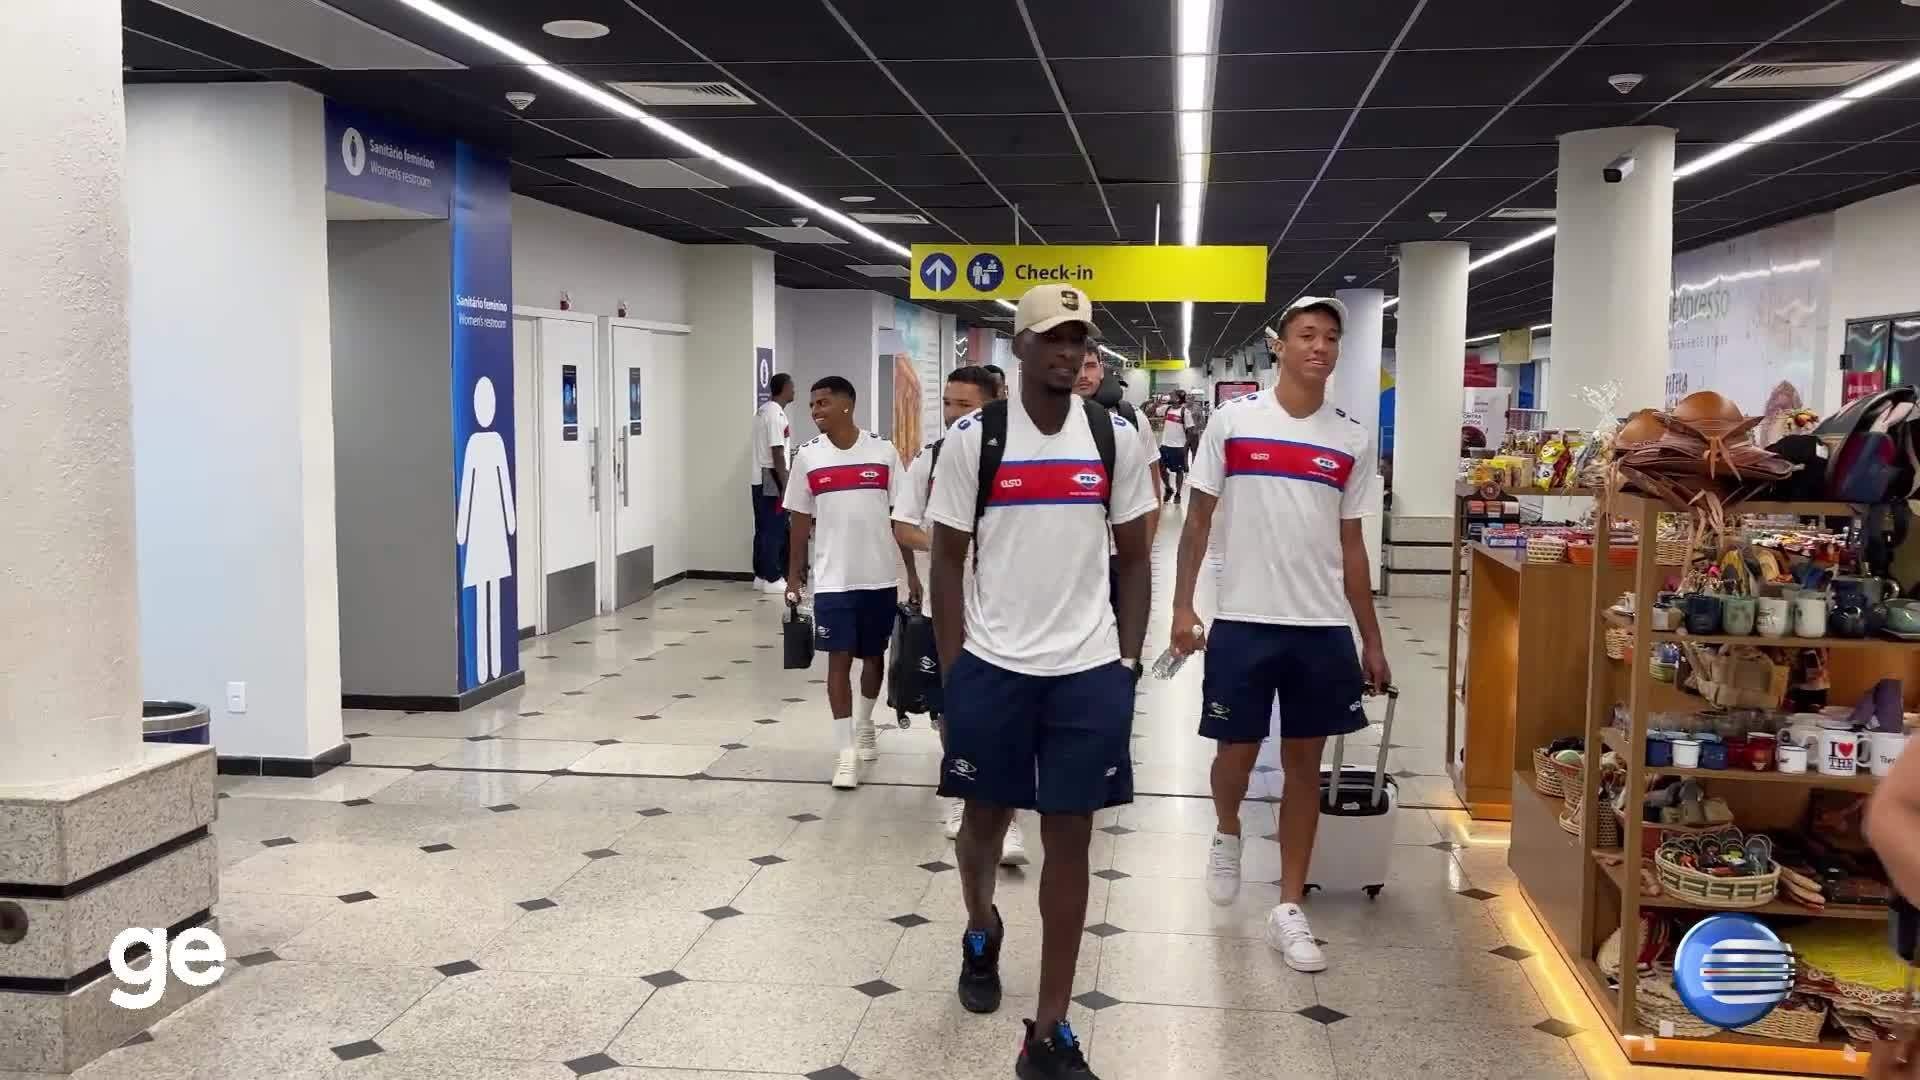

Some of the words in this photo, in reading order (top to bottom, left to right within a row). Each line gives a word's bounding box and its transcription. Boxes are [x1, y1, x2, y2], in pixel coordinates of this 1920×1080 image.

[369, 139, 403, 160] Sanitário
[404, 149, 435, 169] feminino
[370, 160, 402, 181] Women's
[402, 172, 432, 189] restroom
[1015, 264, 1093, 280] Check-in
[456, 294, 483, 309] Sanitário
[484, 297, 507, 312] feminino
[1829, 741, 1839, 756] I
